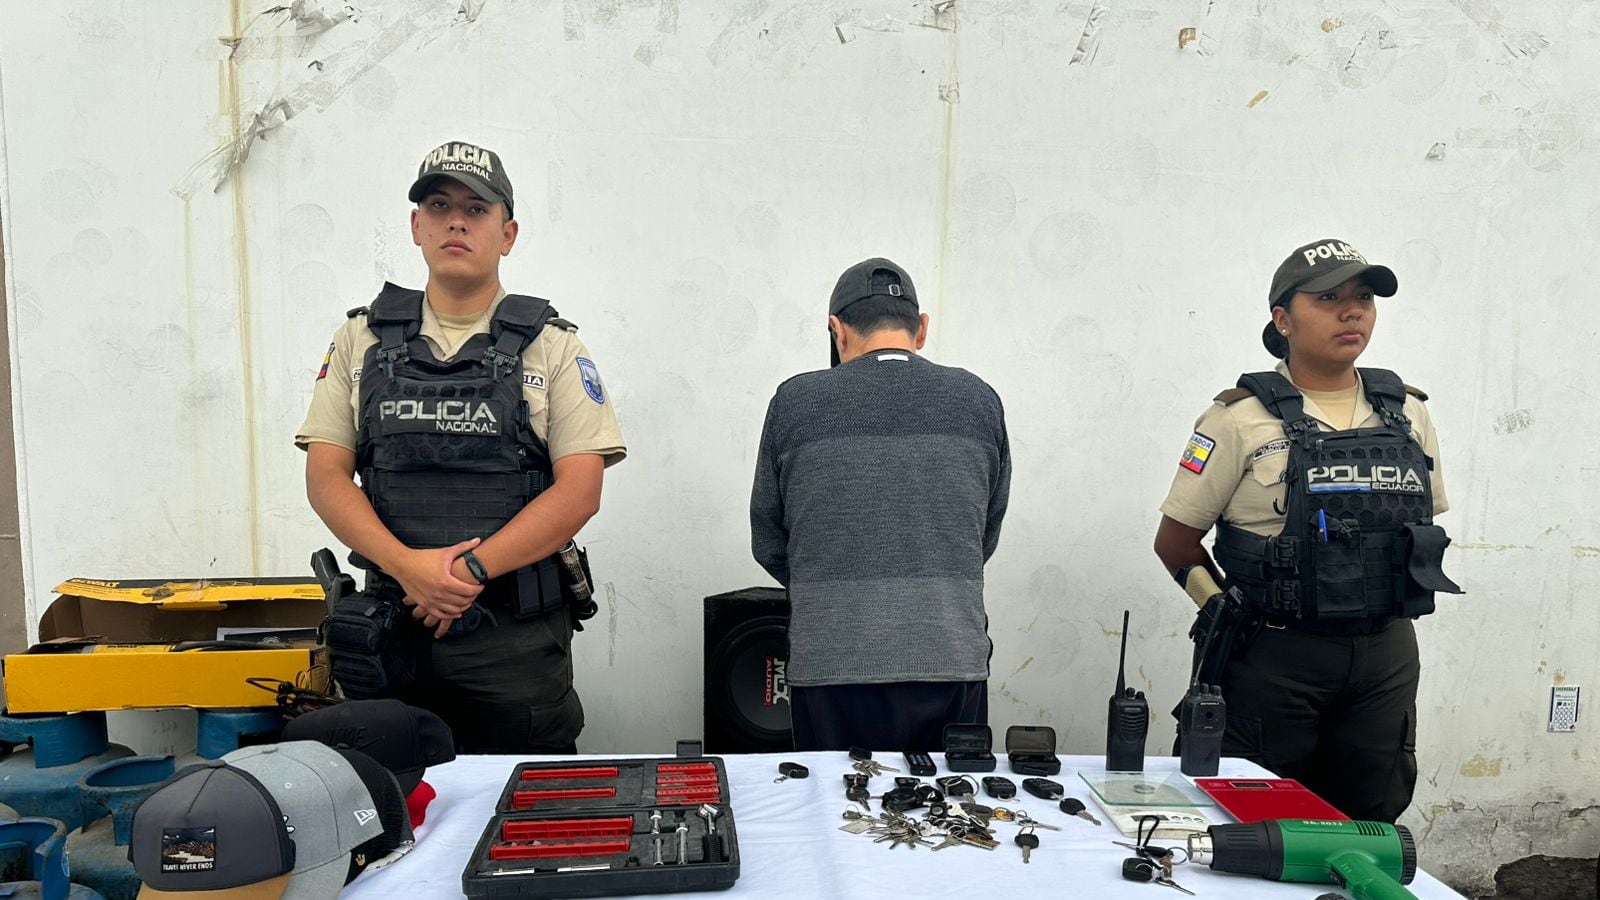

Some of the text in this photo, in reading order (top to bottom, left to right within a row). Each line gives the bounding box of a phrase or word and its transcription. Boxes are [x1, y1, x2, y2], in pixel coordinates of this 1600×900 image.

[424, 143, 493, 174] POLICIA
[442, 162, 491, 181] NACIONAL
[379, 400, 497, 422] POLICIA
[436, 420, 497, 433] NACIONAL
[1307, 465, 1422, 485] POLICIA
[1372, 482, 1424, 493] ECUADOR
[180, 862, 197, 870] NEVER
